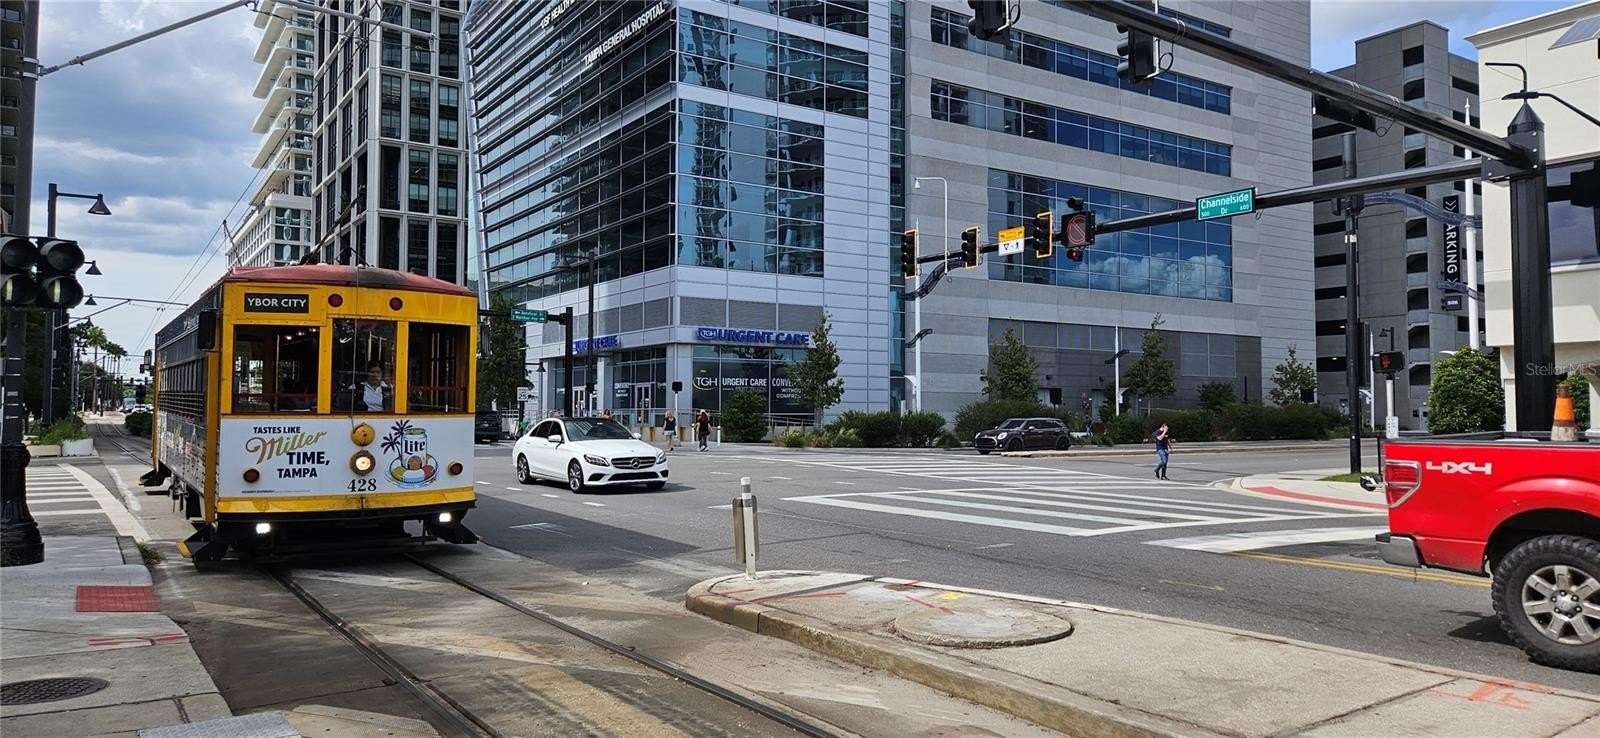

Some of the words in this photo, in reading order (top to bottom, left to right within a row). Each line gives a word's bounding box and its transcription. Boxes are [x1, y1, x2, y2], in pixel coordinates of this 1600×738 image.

[583, 44, 603, 66] TAMPA
[602, 24, 632, 53] GENERAL
[631, 2, 666, 33] HOSPITAL
[1201, 193, 1249, 209] Channelside
[1220, 207, 1228, 215] Dr
[1446, 222, 1458, 274] ARKING
[247, 298, 278, 307] YBOR
[281, 299, 307, 308] CITY
[719, 329, 773, 344] URGENT
[775, 332, 810, 346] CARE
[696, 376, 718, 388] TGH
[722, 377, 748, 386] URGENT
[749, 378, 768, 387] CARE
[253, 426, 282, 434] TASTES
[245, 430, 327, 465] Miller
[404, 439, 426, 455] Lite
[286, 451, 330, 467] TIME,
[277, 467, 318, 479] TAMPA
[347, 478, 377, 493] 428
